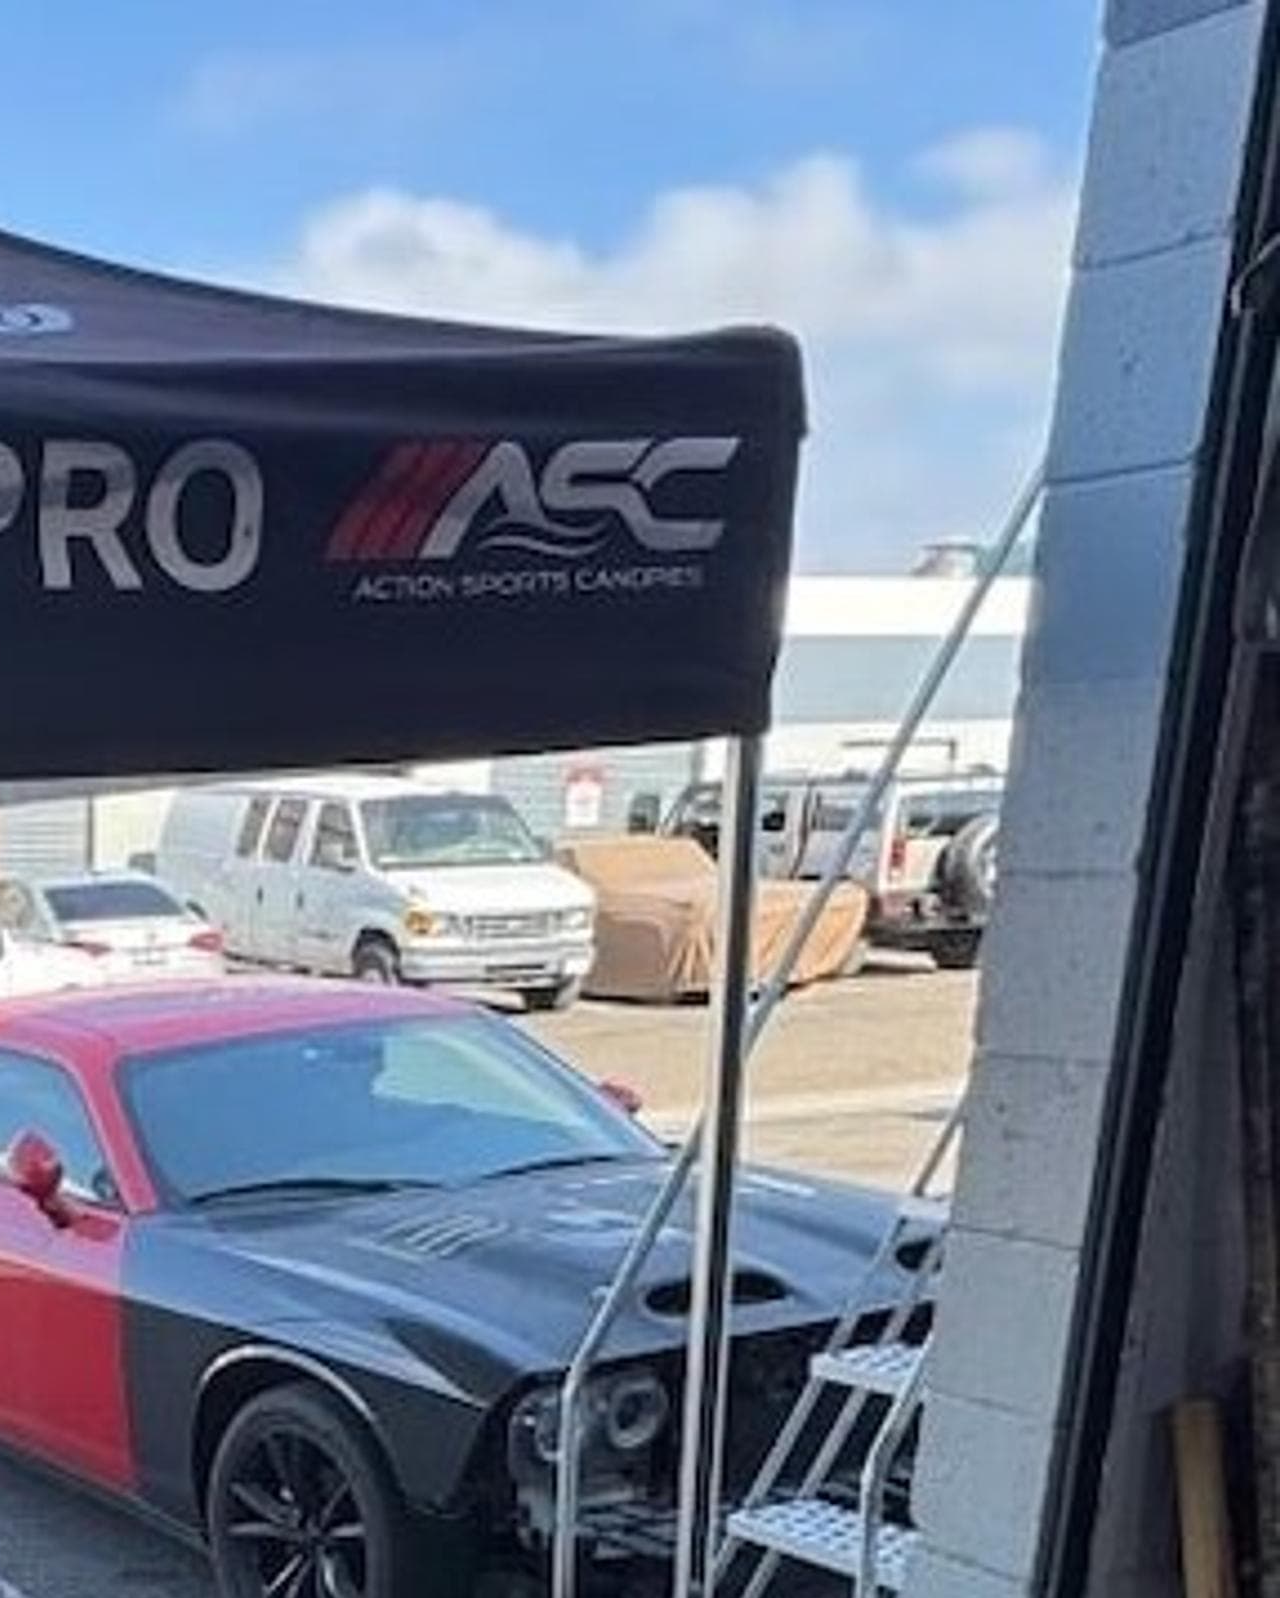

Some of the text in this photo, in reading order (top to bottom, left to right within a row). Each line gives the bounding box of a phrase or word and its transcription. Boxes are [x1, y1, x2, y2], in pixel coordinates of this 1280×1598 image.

[417, 436, 740, 560] ASC
[354, 574, 454, 600] ACTION
[461, 570, 570, 597] SPORTS
